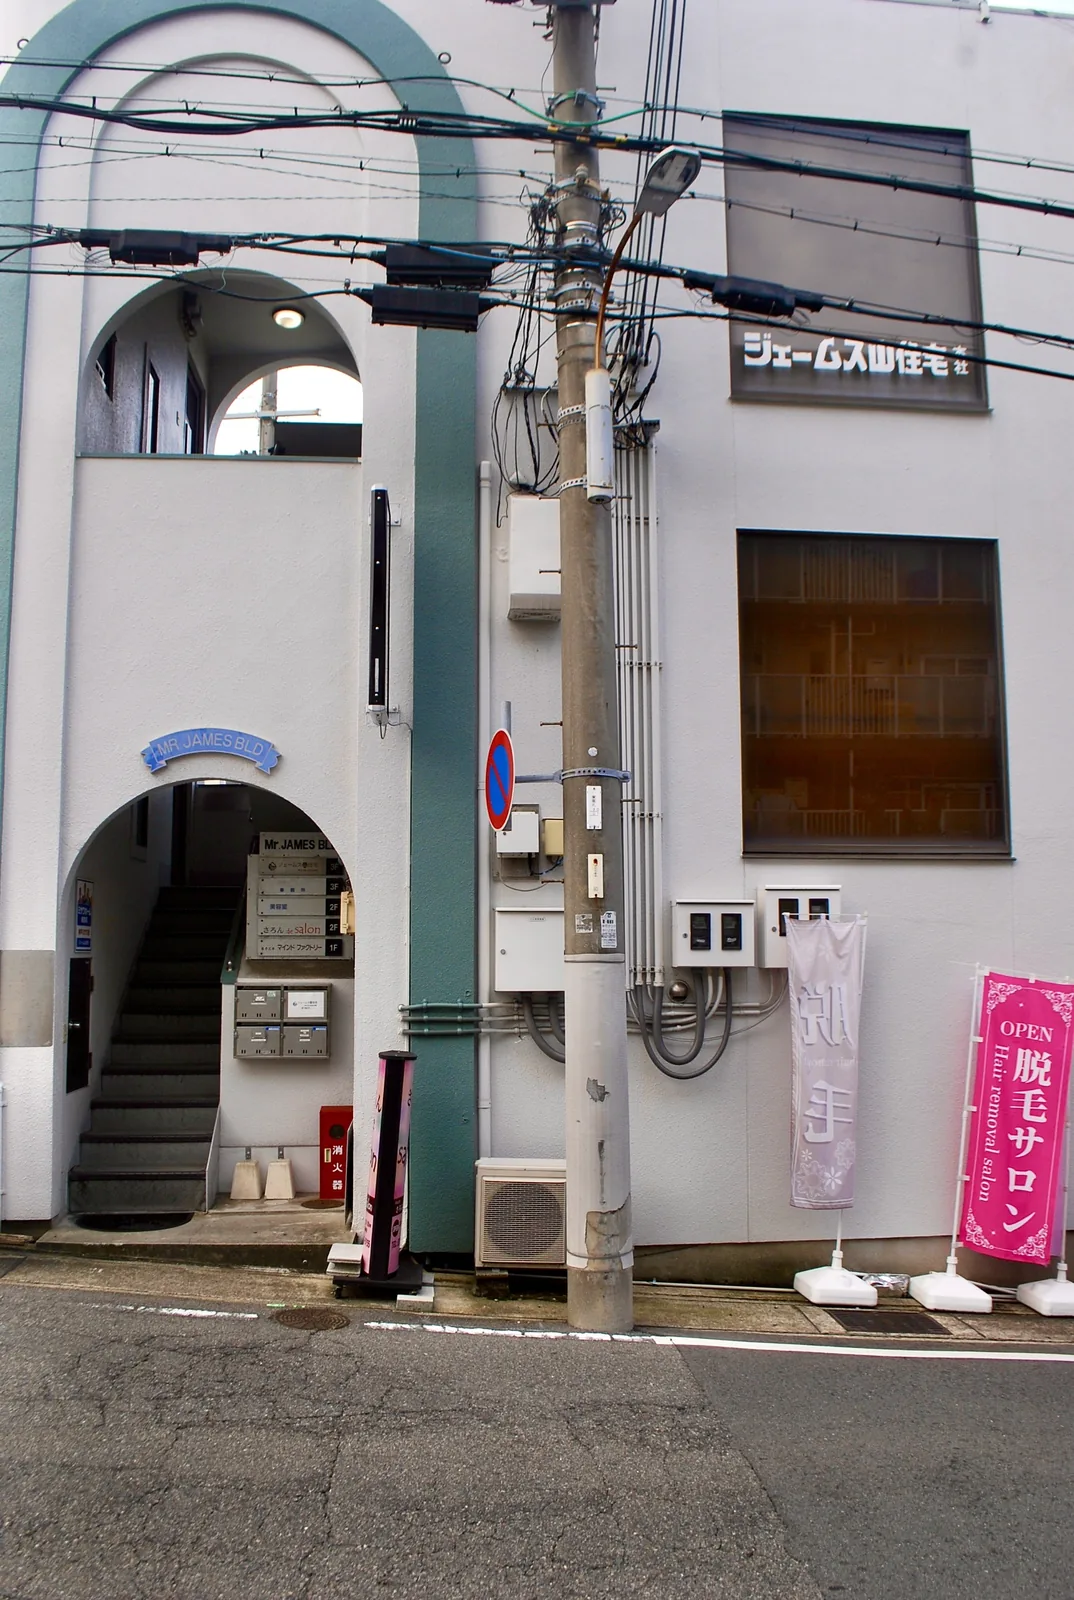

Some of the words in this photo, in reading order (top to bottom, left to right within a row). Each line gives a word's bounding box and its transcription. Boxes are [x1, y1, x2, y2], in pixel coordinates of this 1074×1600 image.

[744, 332, 948, 376] ジェームス山住宅
[157, 738, 179, 756] MR
[183, 733, 232, 749] JAMES
[234, 737, 264, 756] BLD
[318, 839, 335, 850] BL
[329, 883, 339, 891] 3F
[329, 903, 339, 911] 2F
[263, 926, 284, 934] さろん
[294, 922, 321, 935] salon
[329, 923, 339, 931] 2F
[329, 944, 339, 952] 1F
[1000, 1020, 1054, 1043] OPEN
[992, 1043, 1010, 1082] Hair
[984, 1086, 1001, 1154] removal
[1003, 1047, 1053, 1233] 脱毛サロン
[332, 1144, 344, 1191] 消火器
[978, 1157, 997, 1203] salon
